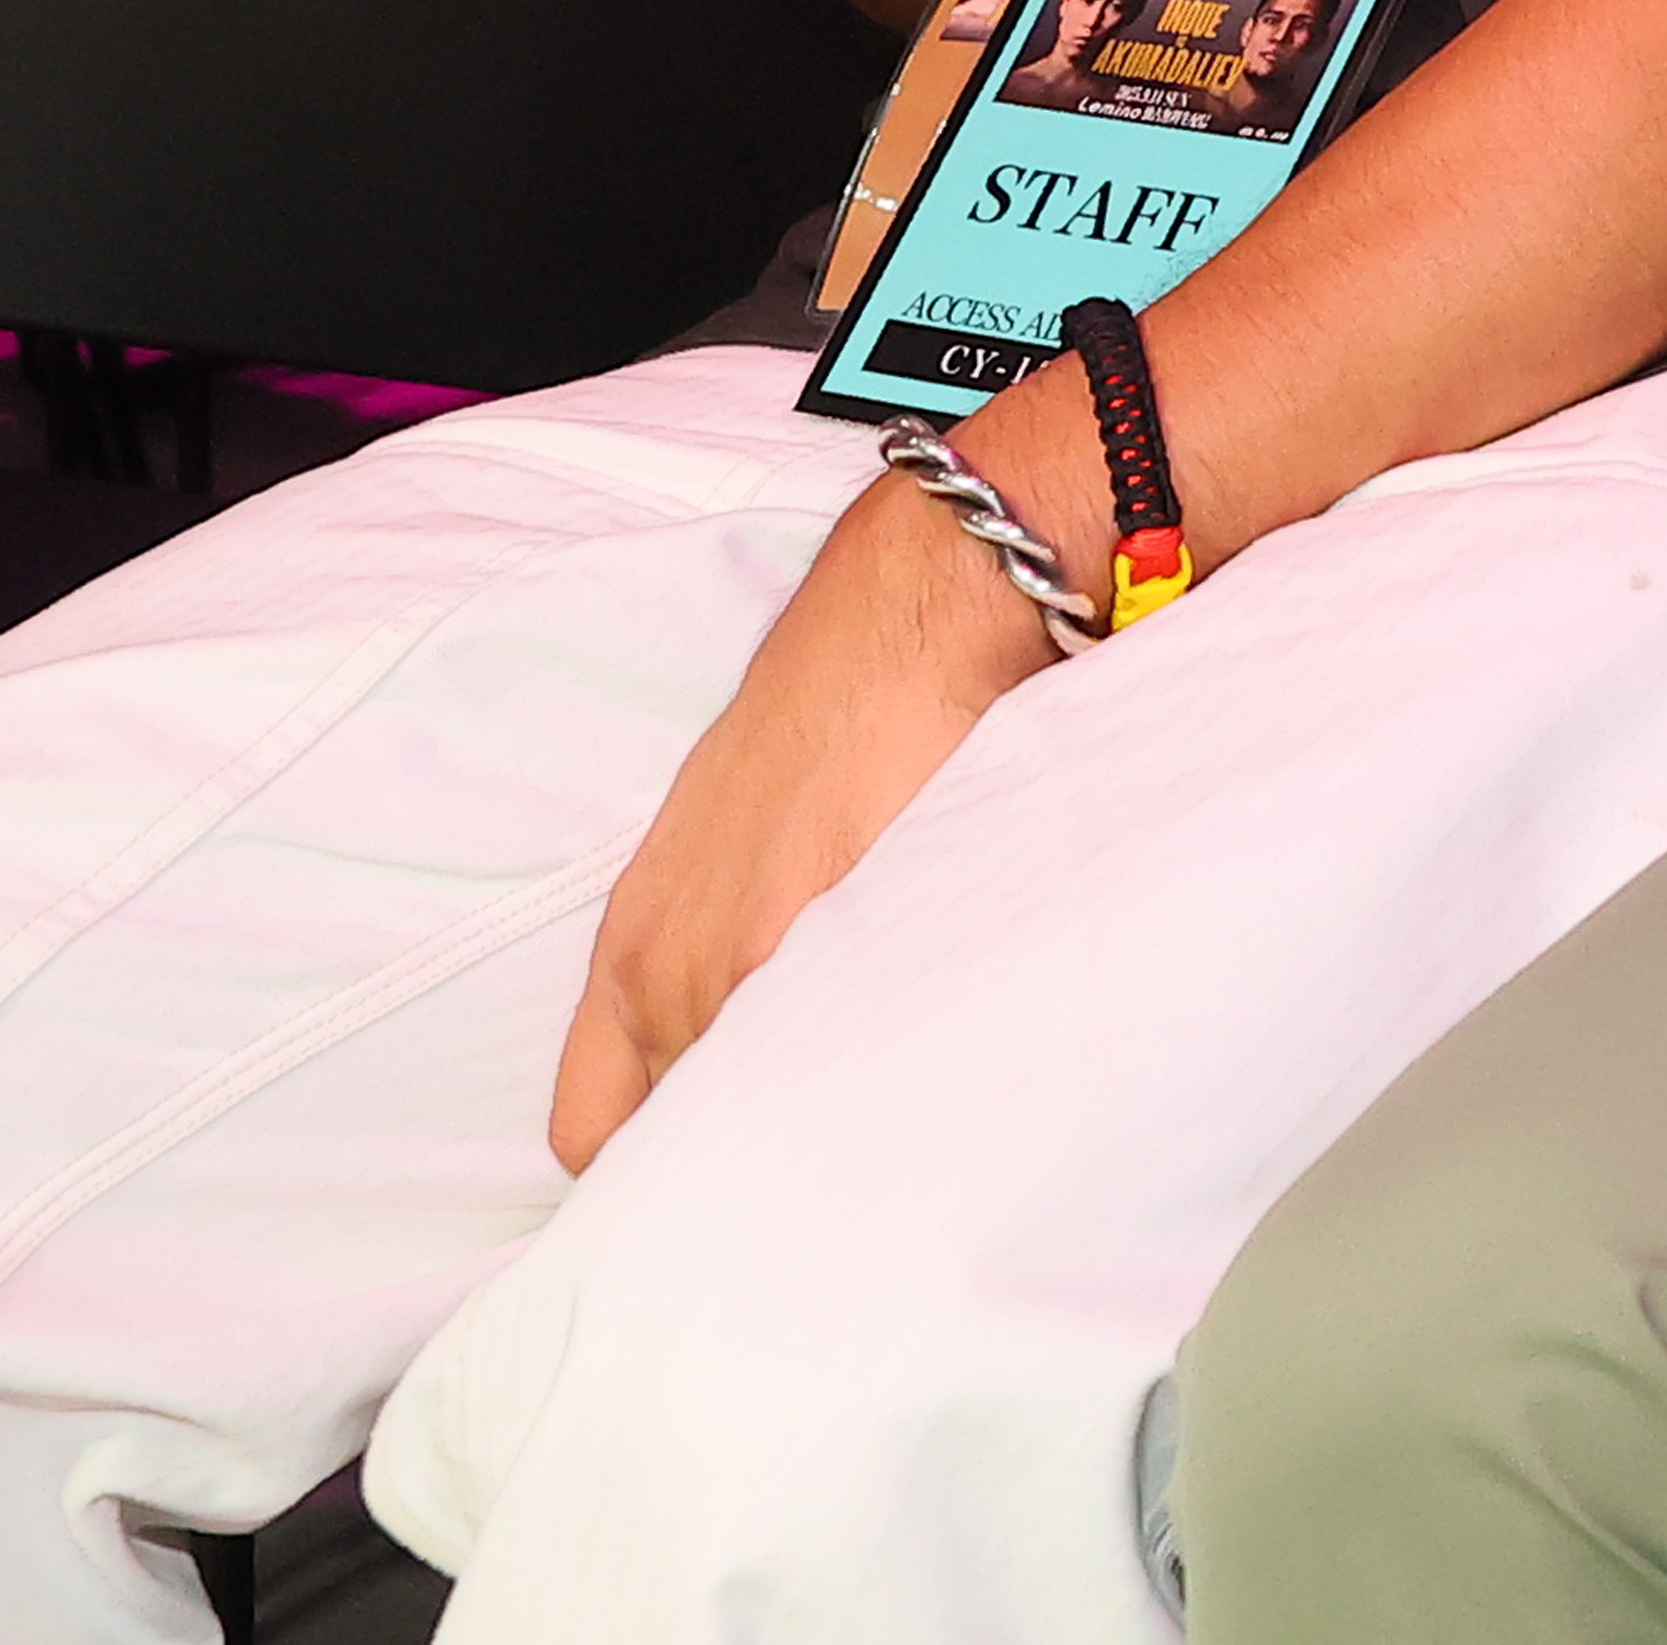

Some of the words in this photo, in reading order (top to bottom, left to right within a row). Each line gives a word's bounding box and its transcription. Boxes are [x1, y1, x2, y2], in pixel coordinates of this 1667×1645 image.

[1078, 95, 1142, 120] Lemino
[967, 163, 1220, 252] STAFF
[902, 290, 1021, 333] ACCESS
[939, 344, 1051, 385] CY-1
